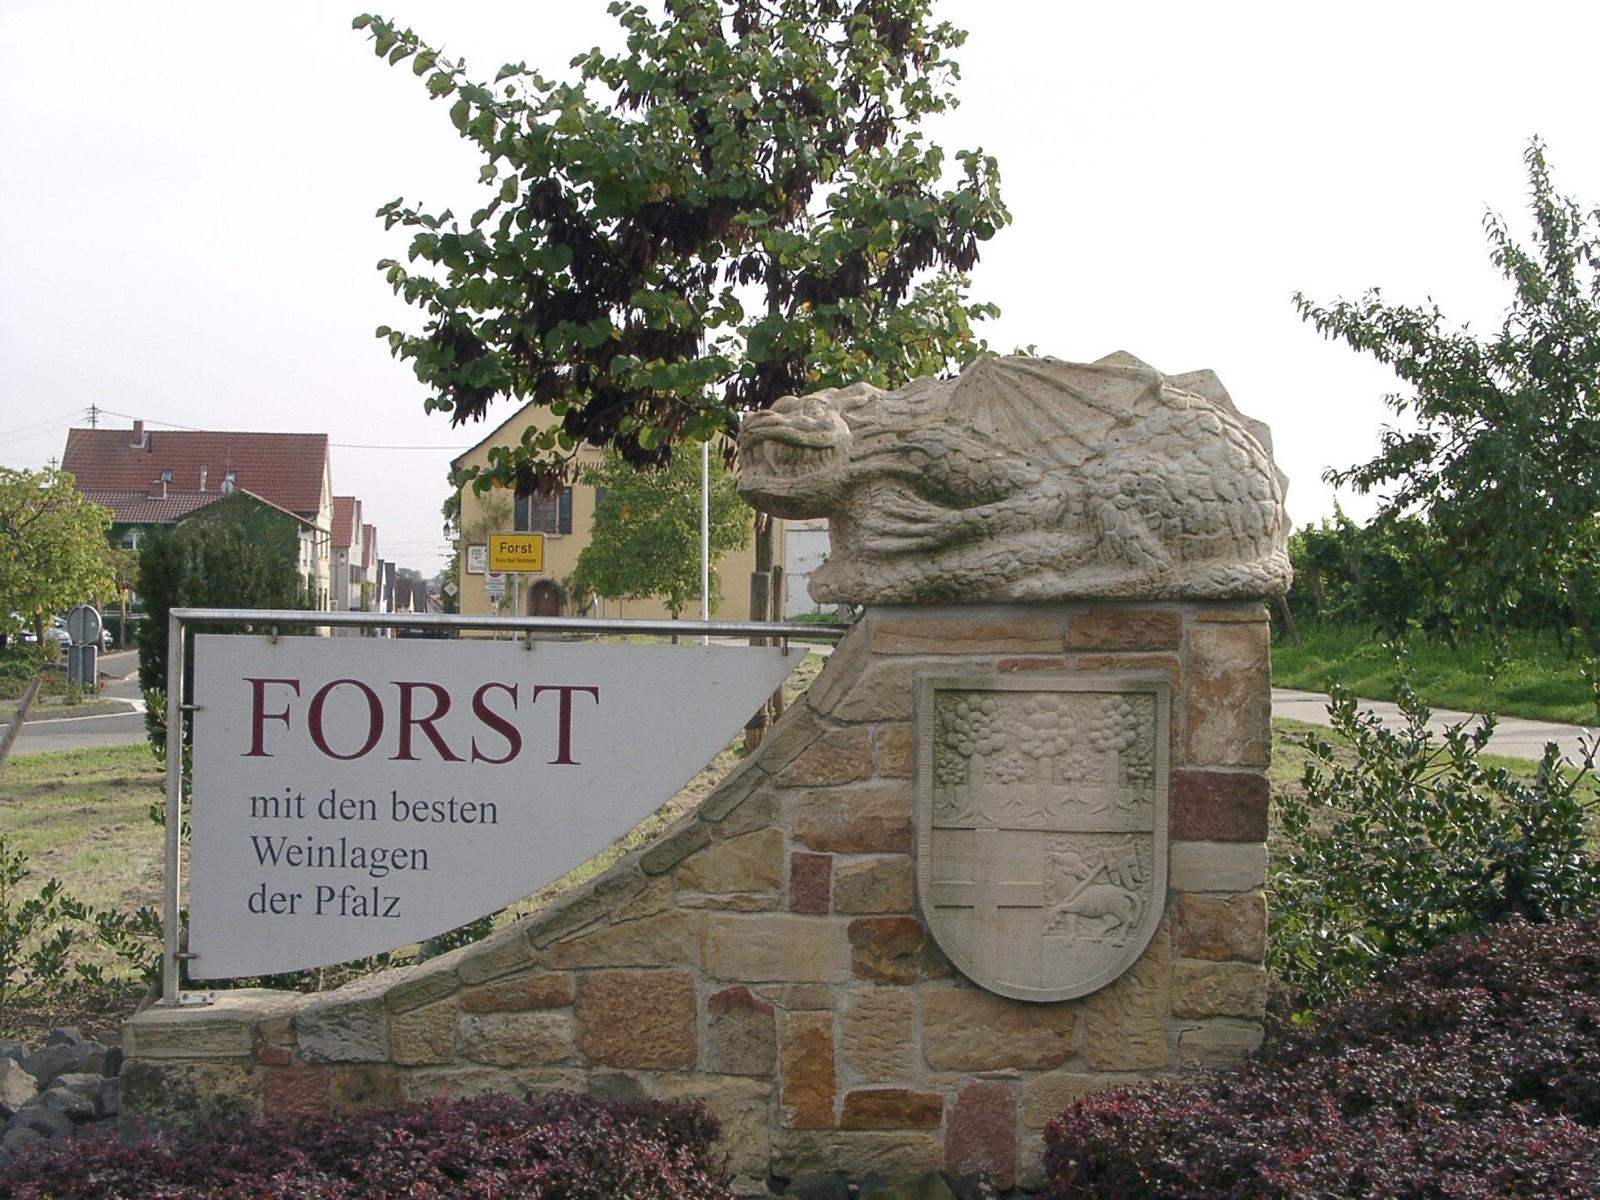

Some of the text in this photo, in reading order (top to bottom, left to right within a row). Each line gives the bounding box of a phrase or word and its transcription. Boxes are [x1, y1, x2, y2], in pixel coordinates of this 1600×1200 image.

[500, 541, 532, 554] Forst
[241, 678, 599, 766] FORST
[249, 787, 498, 824] mit den besten
[249, 835, 430, 878] Weinlagen
[247, 882, 401, 918] der Pfalz
